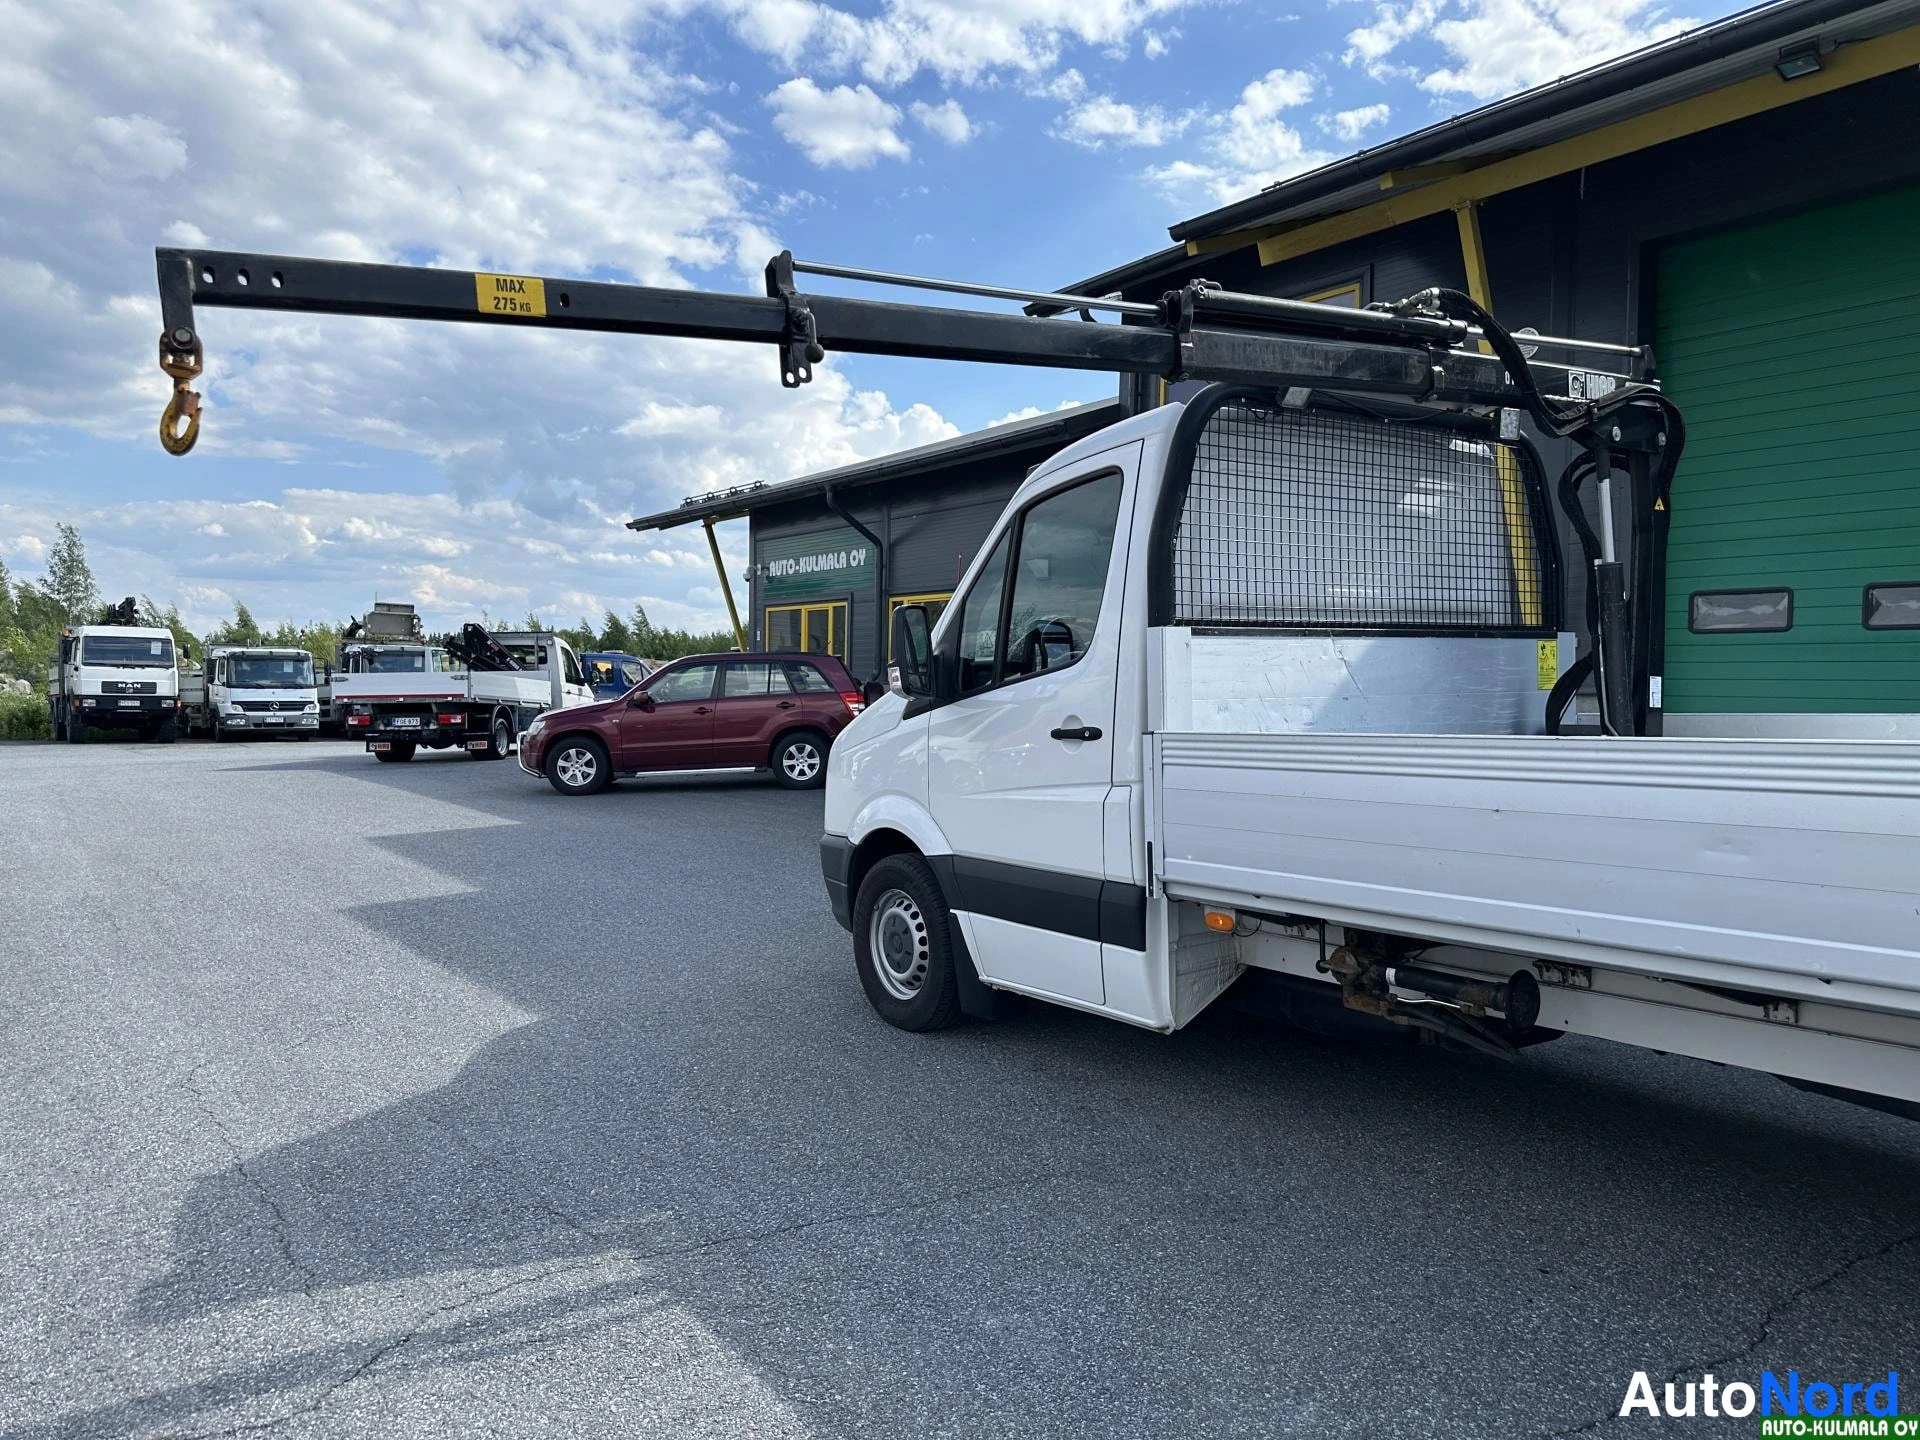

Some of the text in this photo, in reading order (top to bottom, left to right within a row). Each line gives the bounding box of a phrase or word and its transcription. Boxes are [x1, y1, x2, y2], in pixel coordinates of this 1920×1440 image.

[496, 278, 526, 294] MAX
[493, 296, 532, 313] 275 KG
[769, 548, 866, 577] AUTO-KULMALA OY
